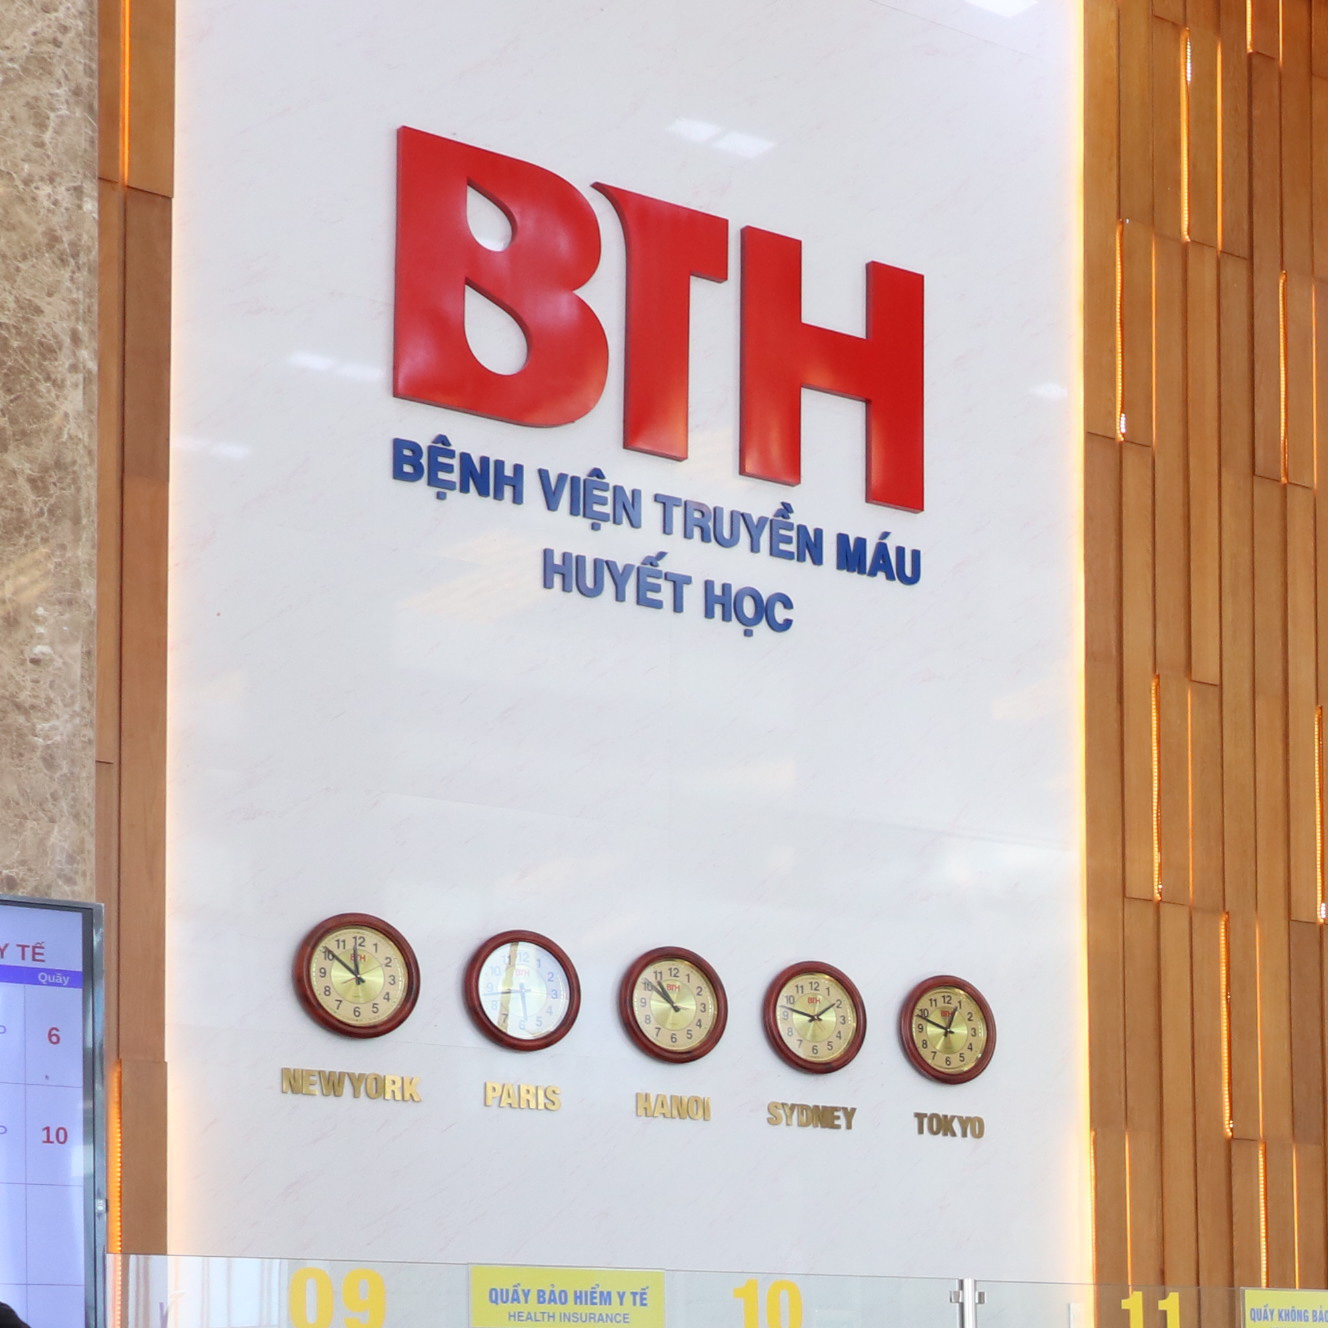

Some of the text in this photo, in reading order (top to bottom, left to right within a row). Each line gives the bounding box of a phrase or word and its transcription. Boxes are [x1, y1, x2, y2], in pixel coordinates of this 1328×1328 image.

[392, 125, 925, 514] BTH
[392, 434, 923, 586] BỆNH VIỆN TRUYỀN MÁU
[542, 548, 794, 638] HUYẾT HỌC
[335, 939, 346, 950] 11
[353, 936, 366, 947] 12
[323, 951, 334, 961] 10
[384, 957, 392, 967] 2
[319, 967, 327, 978] 9
[388, 975, 396, 985] 3
[324, 986, 331, 996] 8
[383, 992, 390, 1001] 4
[942, 995, 952, 1005] 12
[335, 1000, 342, 1010] 7
[929, 998, 938, 1007] 11
[353, 1007, 361, 1017] 6
[372, 1003, 379, 1014] 5
[919, 1008, 929, 1017] 10
[967, 1012, 974, 1021] 2
[917, 1023, 924, 1033] 9
[971, 1027, 977, 1037] 3
[47, 1027, 61, 1045] 6
[922, 1039, 928, 1049] 8
[967, 1042, 973, 1052] 4
[931, 1051, 938, 1060] 7
[959, 1052, 965, 1062] 5
[945, 1056, 951, 1066] 6
[281, 1067, 422, 1102] NEWYORK
[484, 1081, 562, 1111] PARIS
[635, 1091, 711, 1121] HANOI
[767, 1101, 858, 1130] SYDNEY
[914, 1112, 985, 1139] TOKYO
[41, 1126, 68, 1144] 10
[536, 1283, 568, 1306] BẢO
[573, 1284, 612, 1307] HIỂM
[616, 1290, 627, 1306] Y
[631, 1286, 649, 1307] TẾ
[508, 1311, 630, 1324] HEALTH INSURANCE
[1277, 1306, 1309, 1323] KHÔNG
